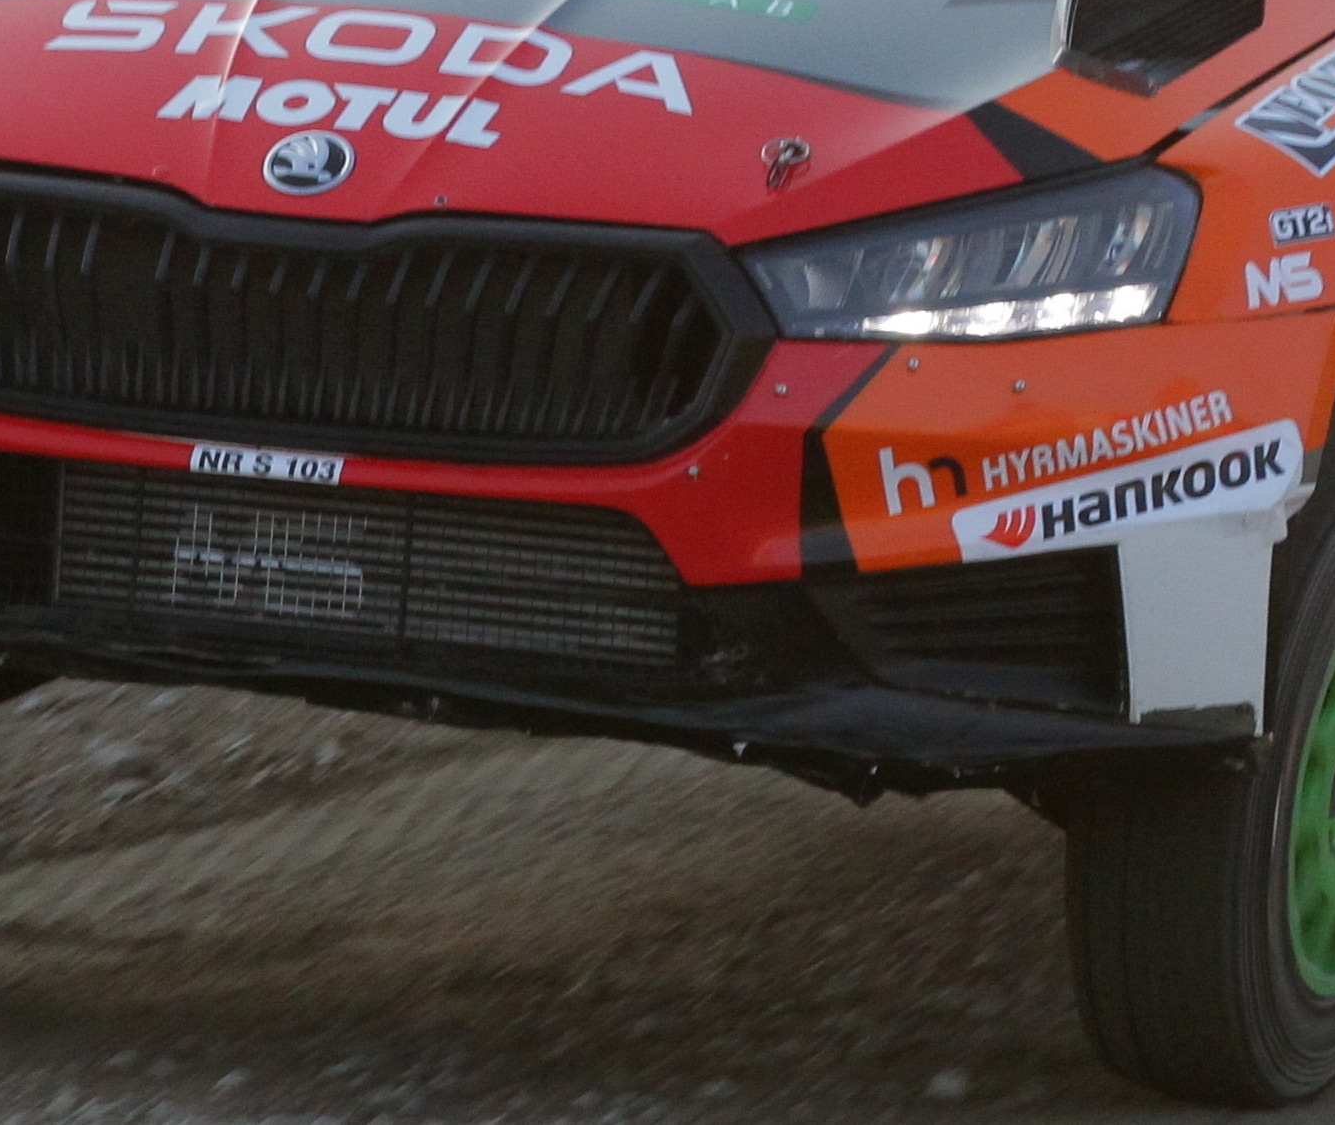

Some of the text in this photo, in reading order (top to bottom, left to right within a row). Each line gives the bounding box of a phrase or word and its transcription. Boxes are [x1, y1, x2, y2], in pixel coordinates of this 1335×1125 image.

[156, 73, 502, 149] MOTUL
[198, 446, 337, 481] NR S 103
[981, 390, 1234, 493] HYRMASKINER
